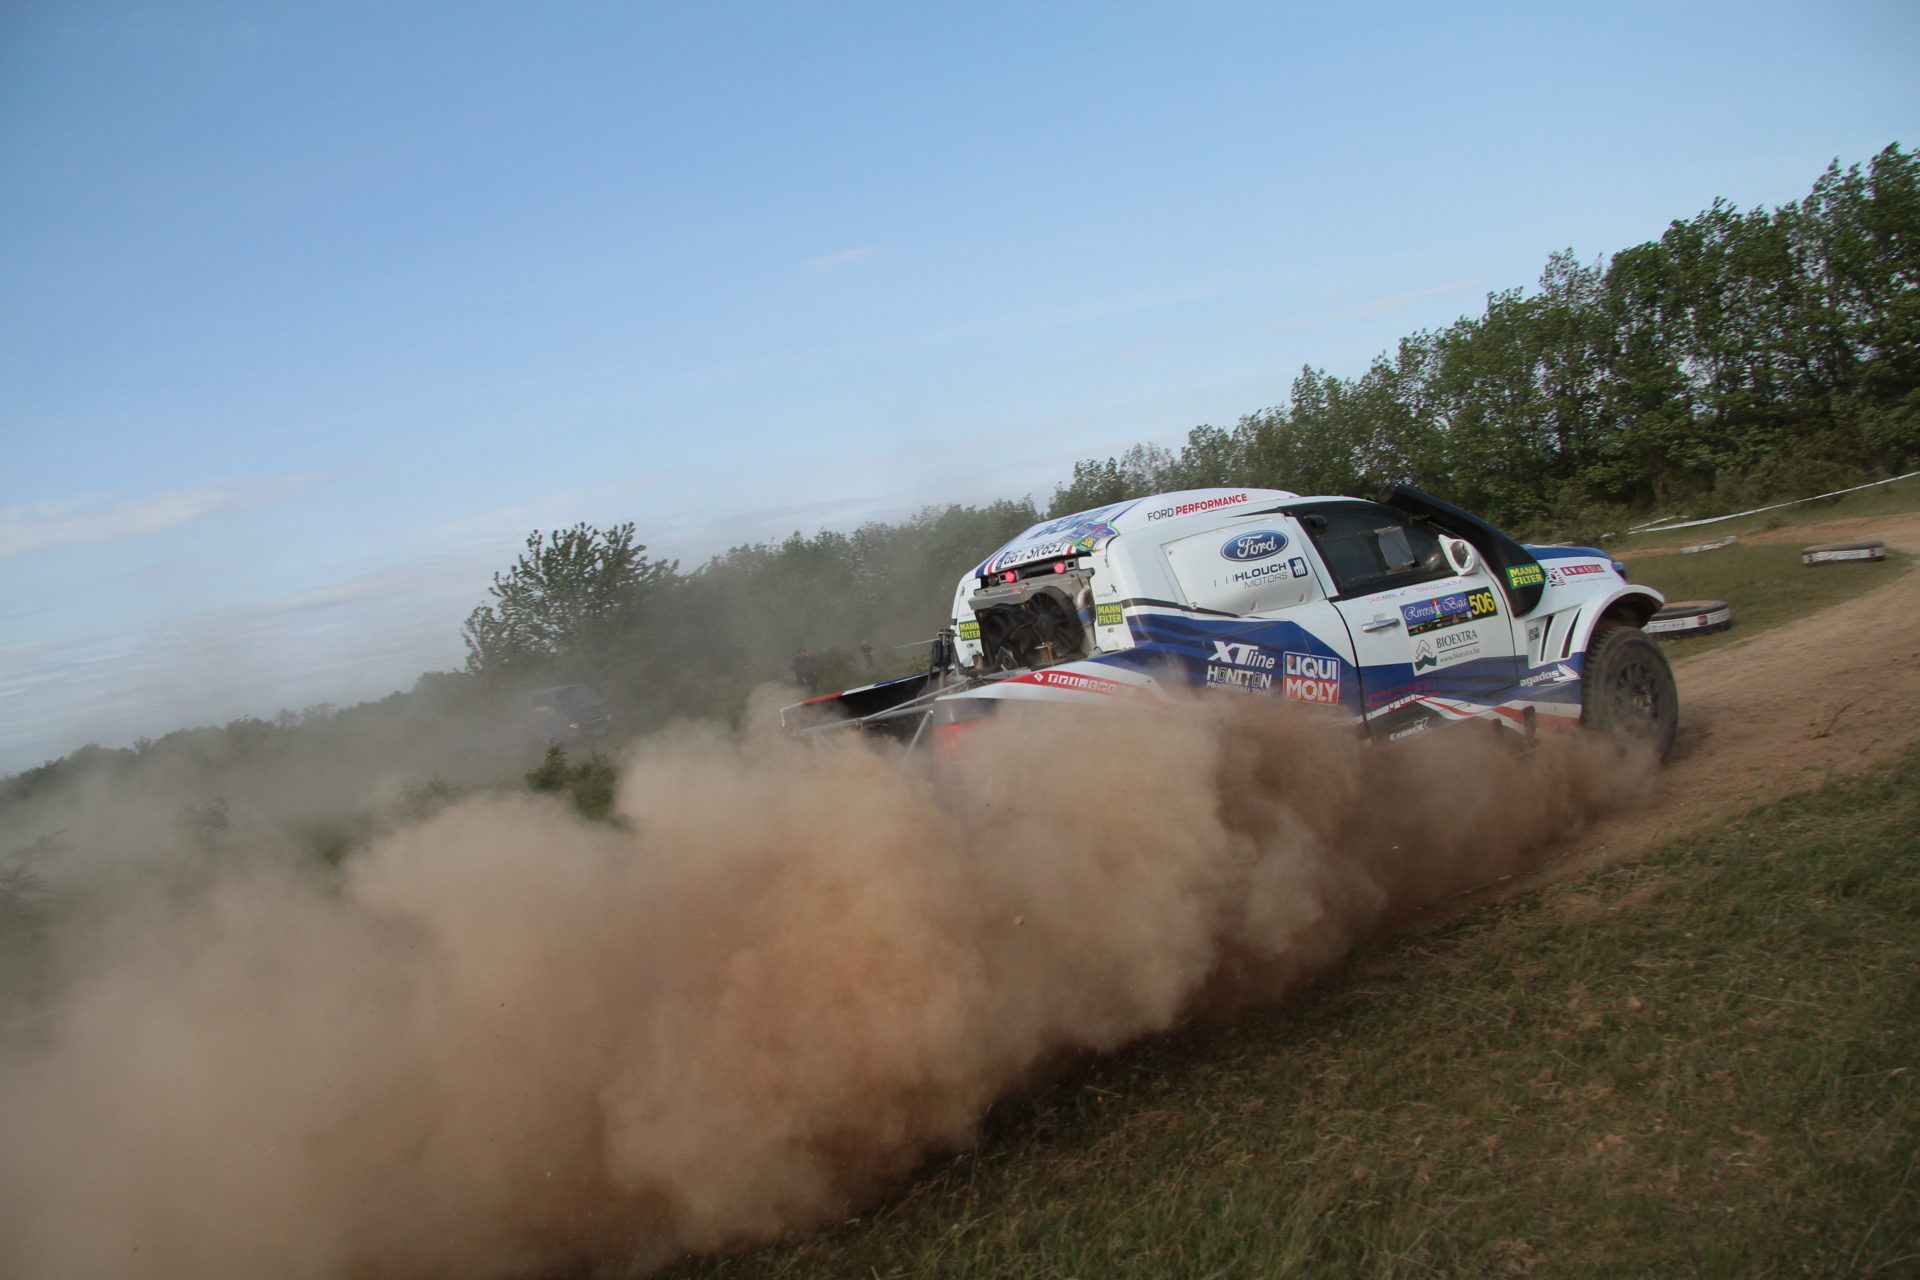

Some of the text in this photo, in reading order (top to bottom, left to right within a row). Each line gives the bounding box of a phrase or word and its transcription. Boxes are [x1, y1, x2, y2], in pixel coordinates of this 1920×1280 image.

[1147, 493, 1248, 521] FORD PERFORMANCE
[1236, 534, 1277, 558] Ford
[1235, 562, 1287, 582] HLOUCH
[1244, 571, 1288, 589] MOTORS
[1509, 565, 1540, 577] MANN
[1511, 574, 1543, 587] FILTER
[1097, 604, 1121, 615] MANN
[1468, 591, 1496, 616] 506
[959, 621, 979, 632] MANN
[1098, 613, 1122, 625] FILTER
[961, 630, 981, 640] FILTER
[1435, 629, 1478, 649] BIOEXTRA
[1286, 654, 1337, 680] LIQUI
[1519, 669, 1560, 687] agados
[1285, 678, 1338, 703] MOLY
